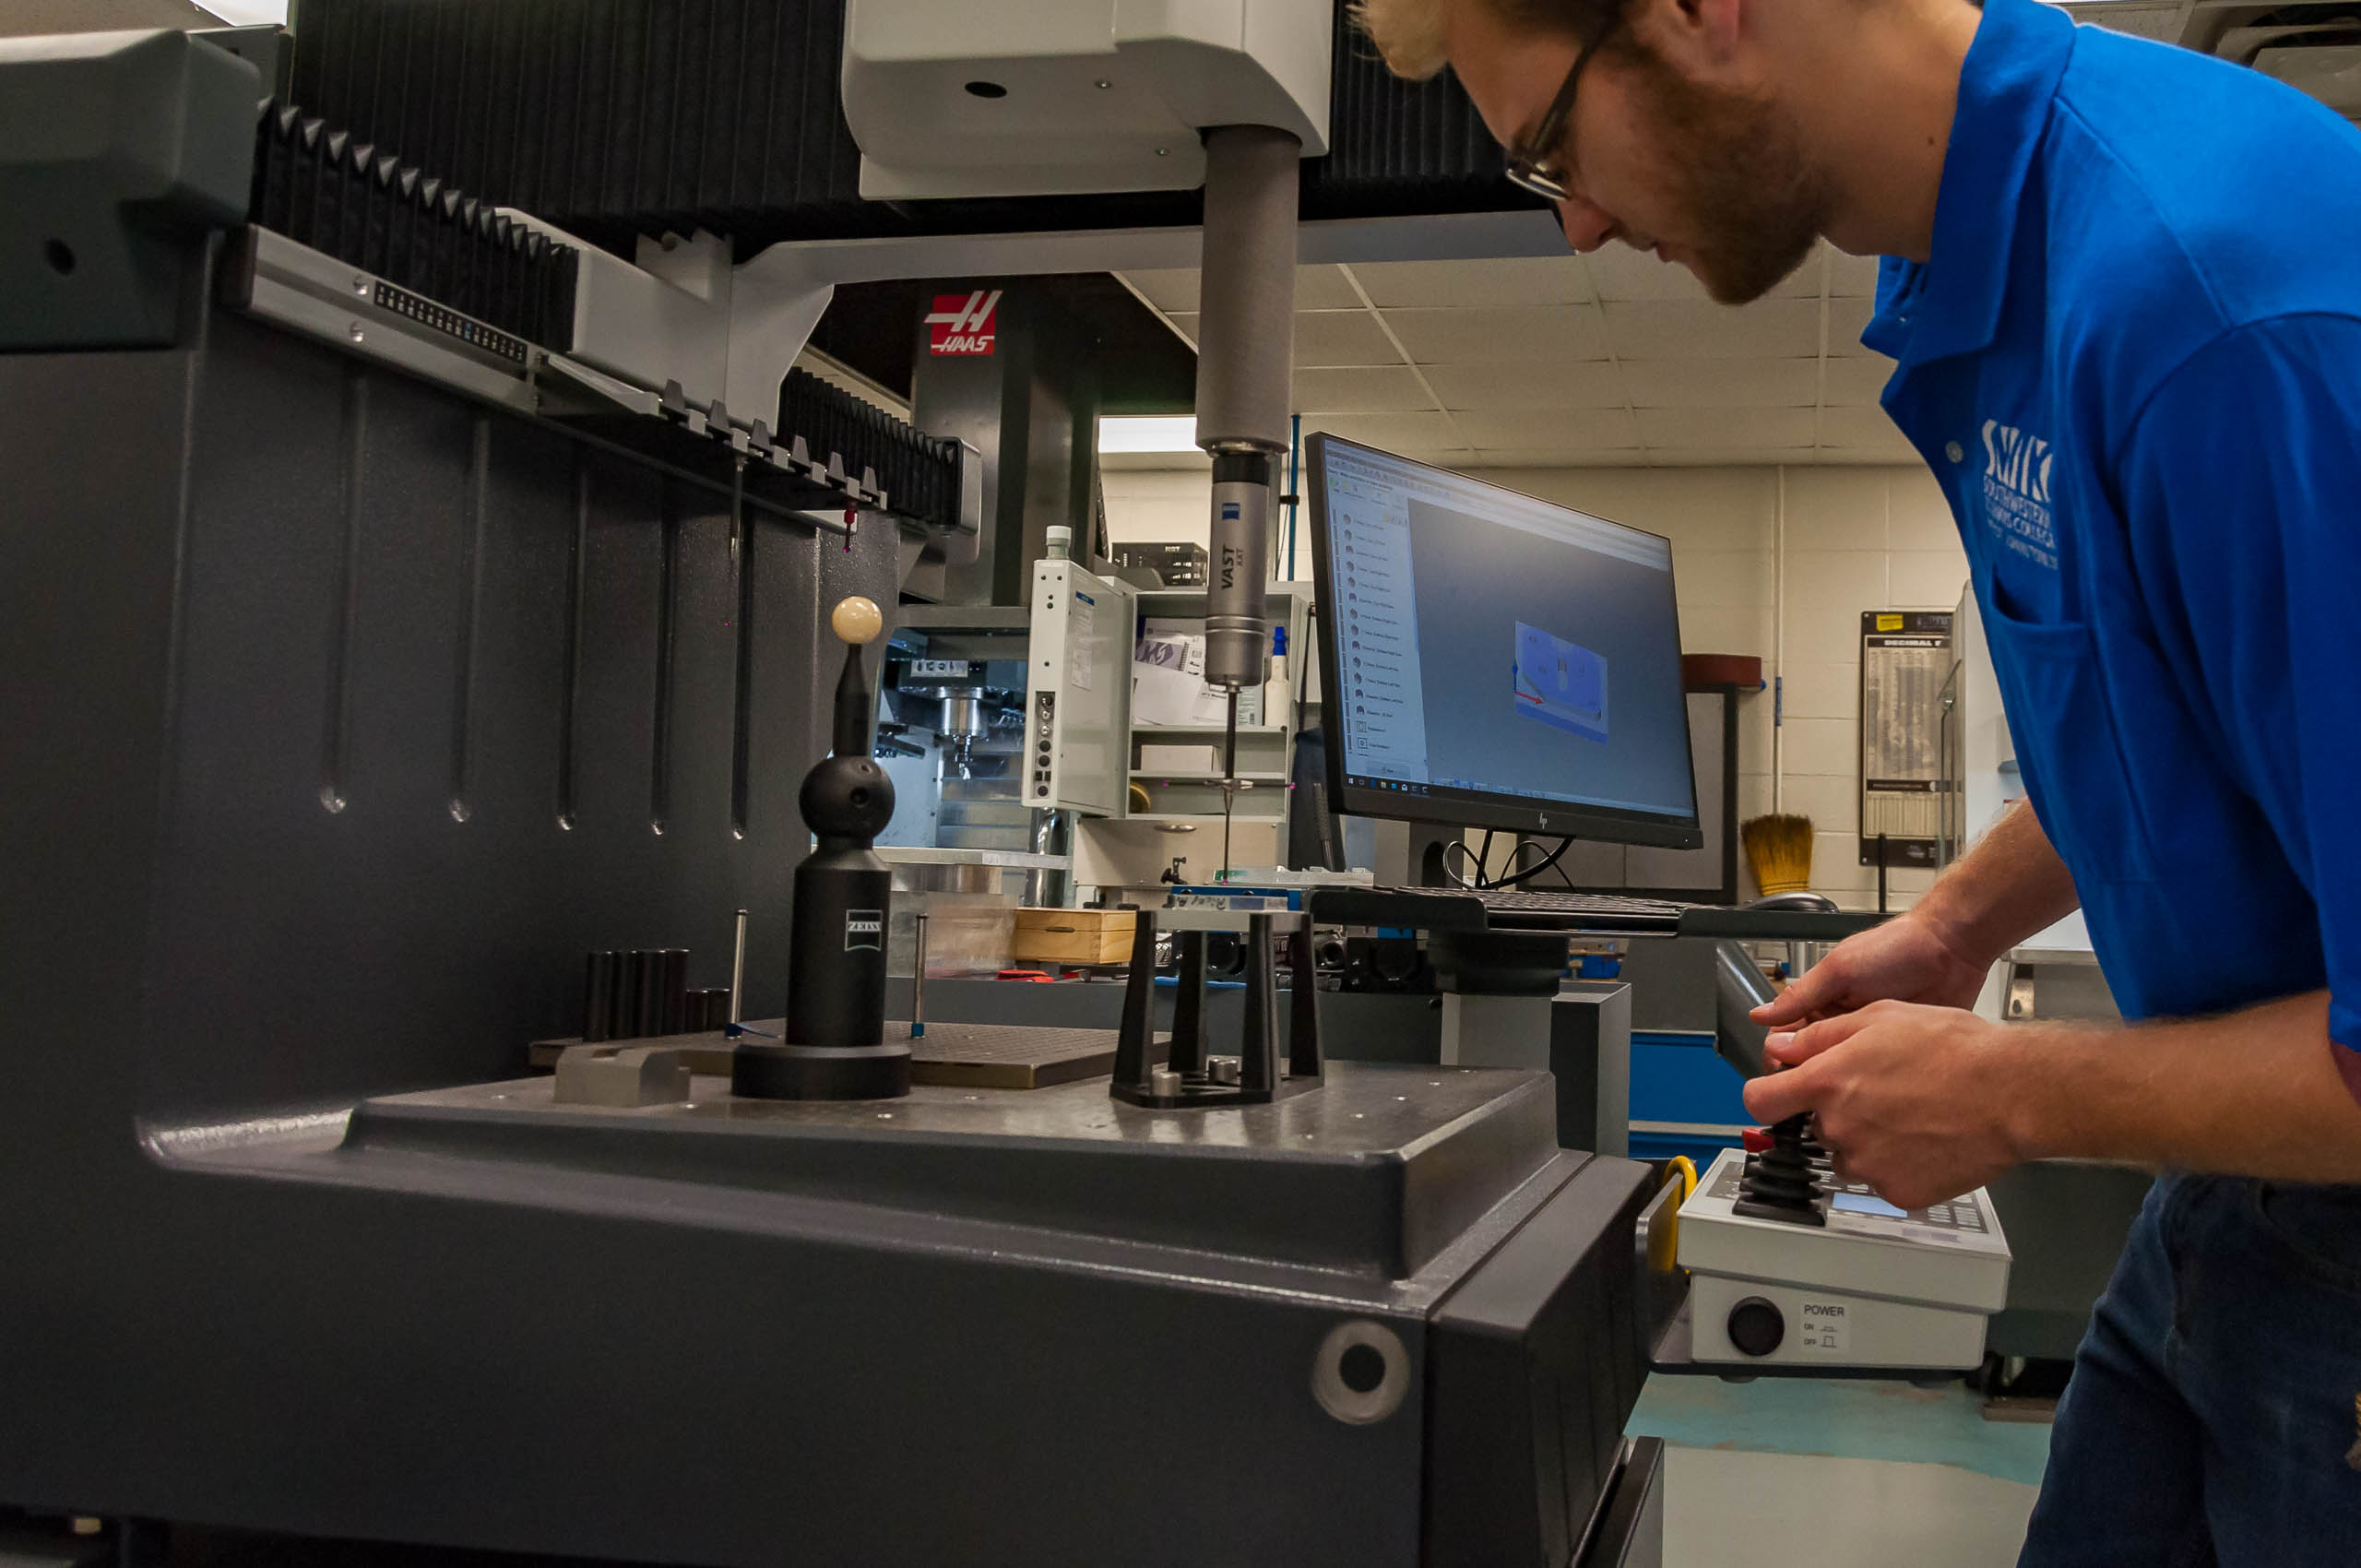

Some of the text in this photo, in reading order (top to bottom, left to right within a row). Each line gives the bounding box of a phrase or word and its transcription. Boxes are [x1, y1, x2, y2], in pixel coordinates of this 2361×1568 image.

[931, 335, 995, 352] HAAS
[1221, 543, 1235, 590] VAST
[848, 921, 882, 932] ZEISS
[1804, 1304, 1845, 1317] POWER
